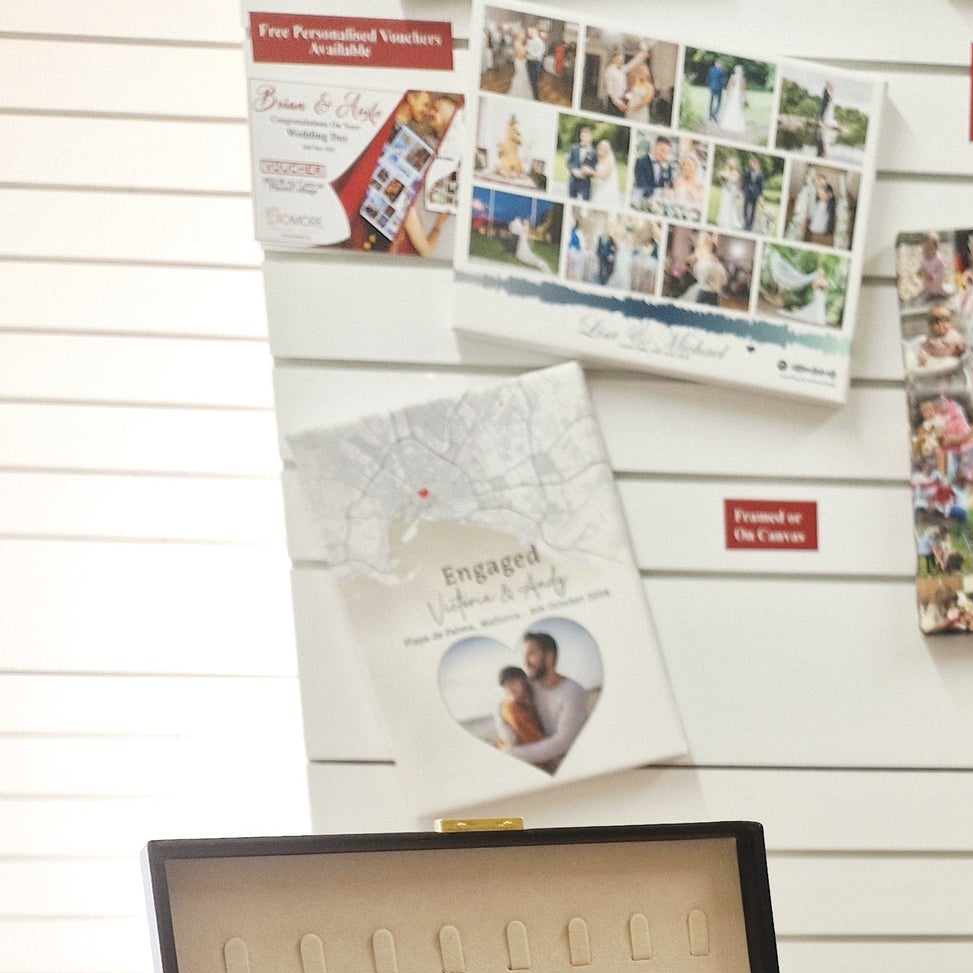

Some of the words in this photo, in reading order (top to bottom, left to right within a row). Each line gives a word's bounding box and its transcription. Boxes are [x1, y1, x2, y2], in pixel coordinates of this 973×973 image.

[258, 23, 289, 39] Free
[293, 25, 377, 44] Personalised
[379, 29, 442, 47] Vouchers
[309, 42, 372, 58] Available
[733, 508, 785, 525] Framed
[733, 528, 755, 542] On
[757, 528, 806, 544] Canvas
[441, 544, 541, 588] Engaged
